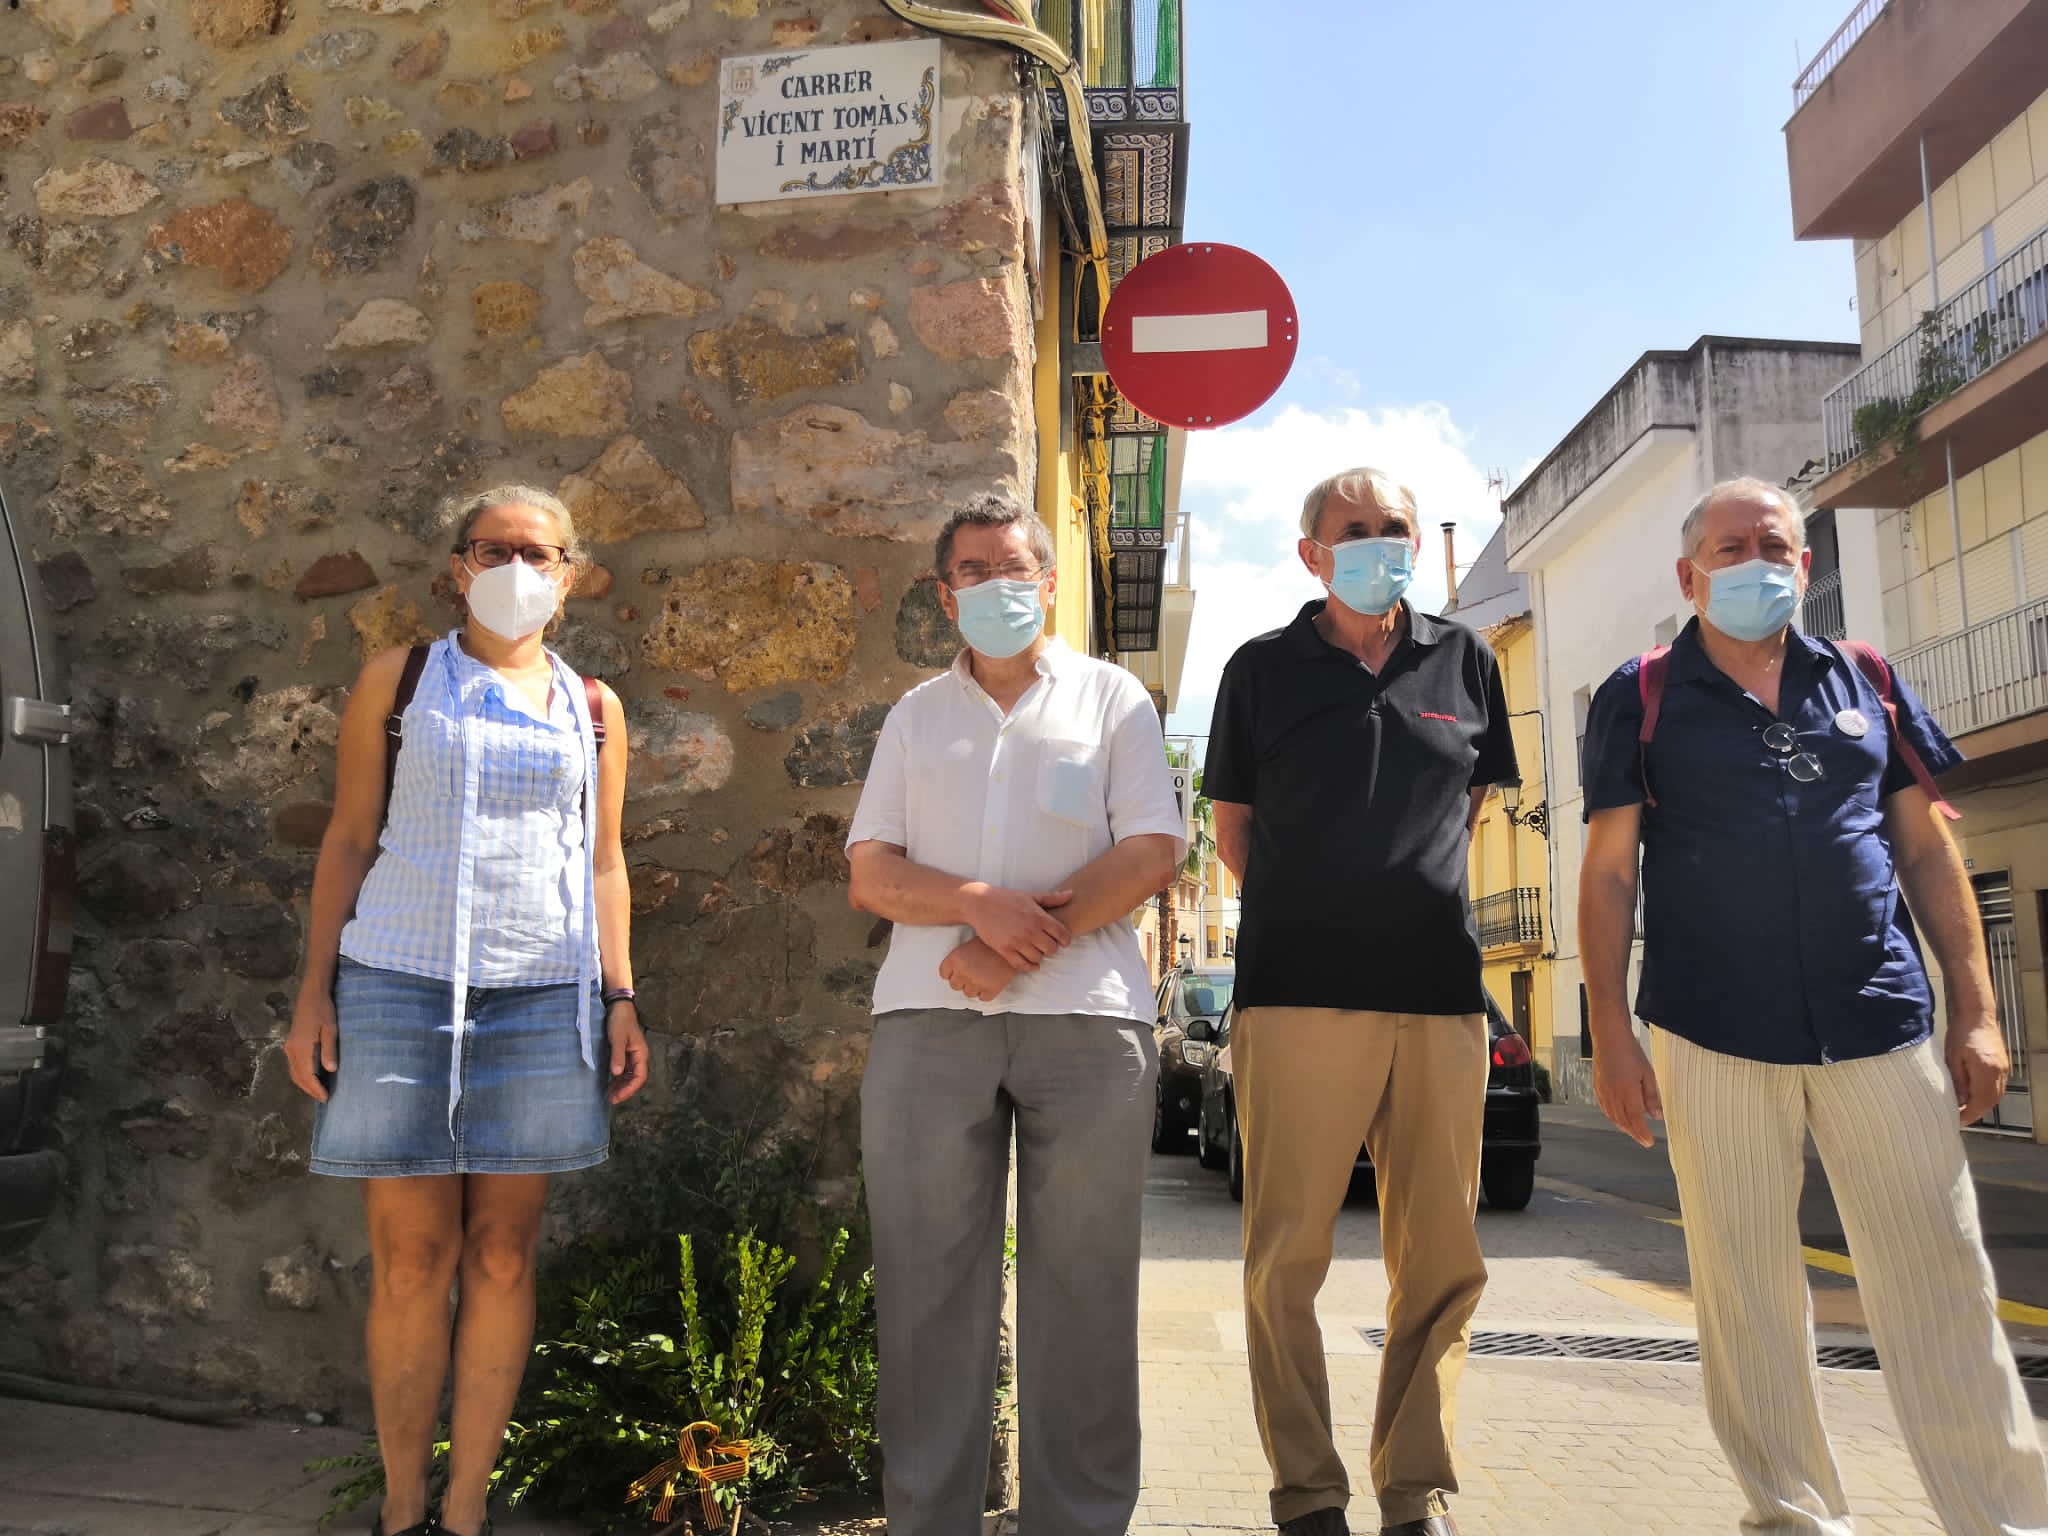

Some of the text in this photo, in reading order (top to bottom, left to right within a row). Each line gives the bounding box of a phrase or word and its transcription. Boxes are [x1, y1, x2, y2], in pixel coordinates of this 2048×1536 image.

[781, 69, 872, 99] CARRER
[834, 95, 908, 129] TOMÀS
[801, 129, 877, 164] MARTÍ
